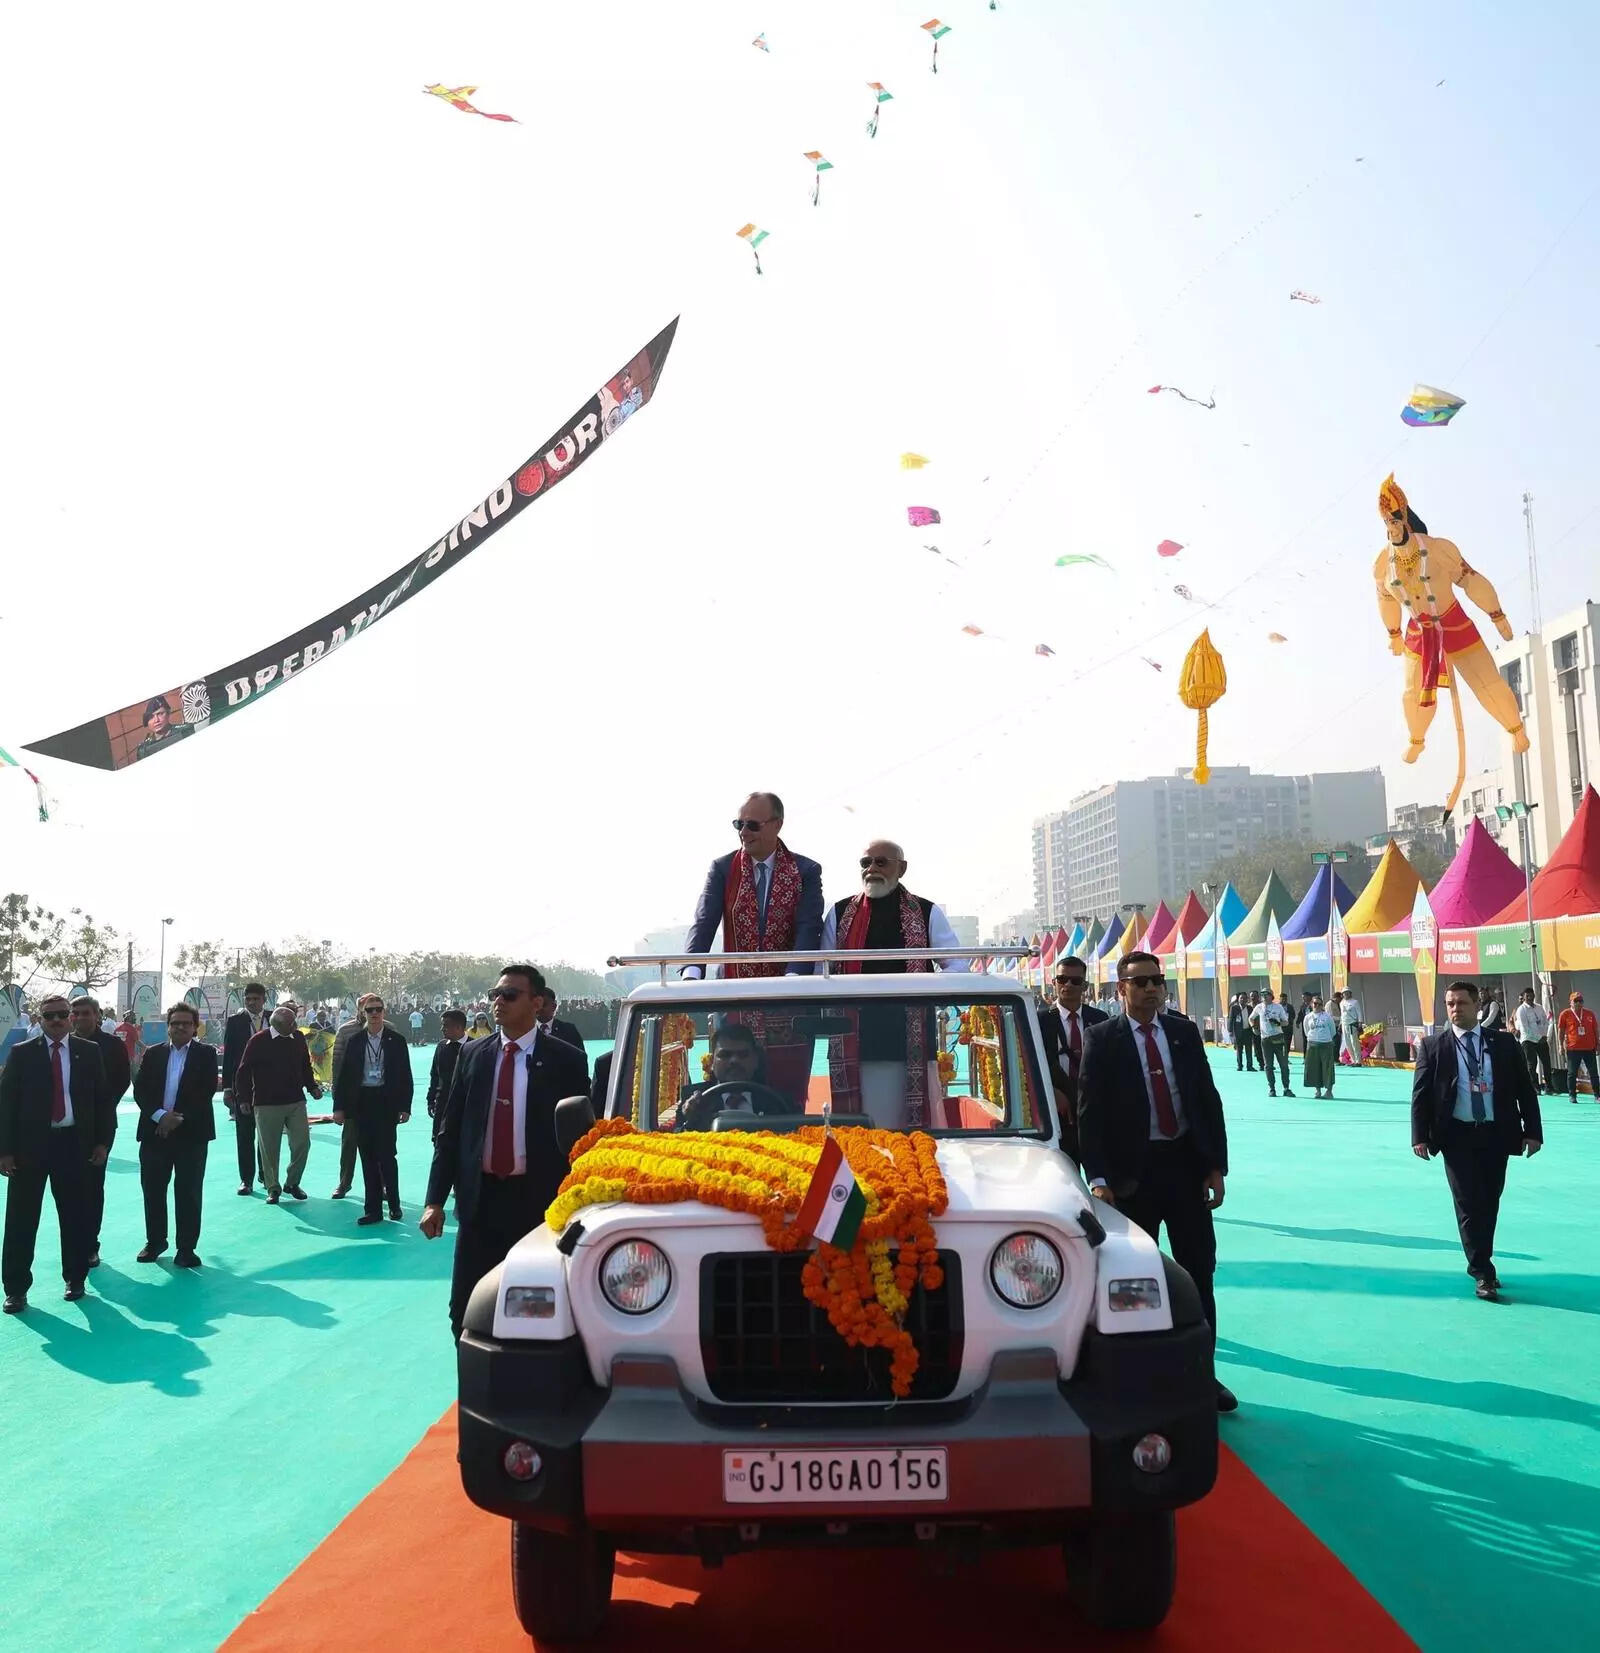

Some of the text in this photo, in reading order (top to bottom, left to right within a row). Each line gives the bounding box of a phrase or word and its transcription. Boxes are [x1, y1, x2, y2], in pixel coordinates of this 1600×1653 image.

[1443, 940, 1471, 951] REPUBLIC
[1486, 944, 1506, 956] JAPAN
[1355, 948, 1375, 958] POLAND
[1452, 954, 1472, 963] KOREA
[729, 1473, 746, 1482] IND
[750, 1459, 941, 1493] GJ18GA0156
